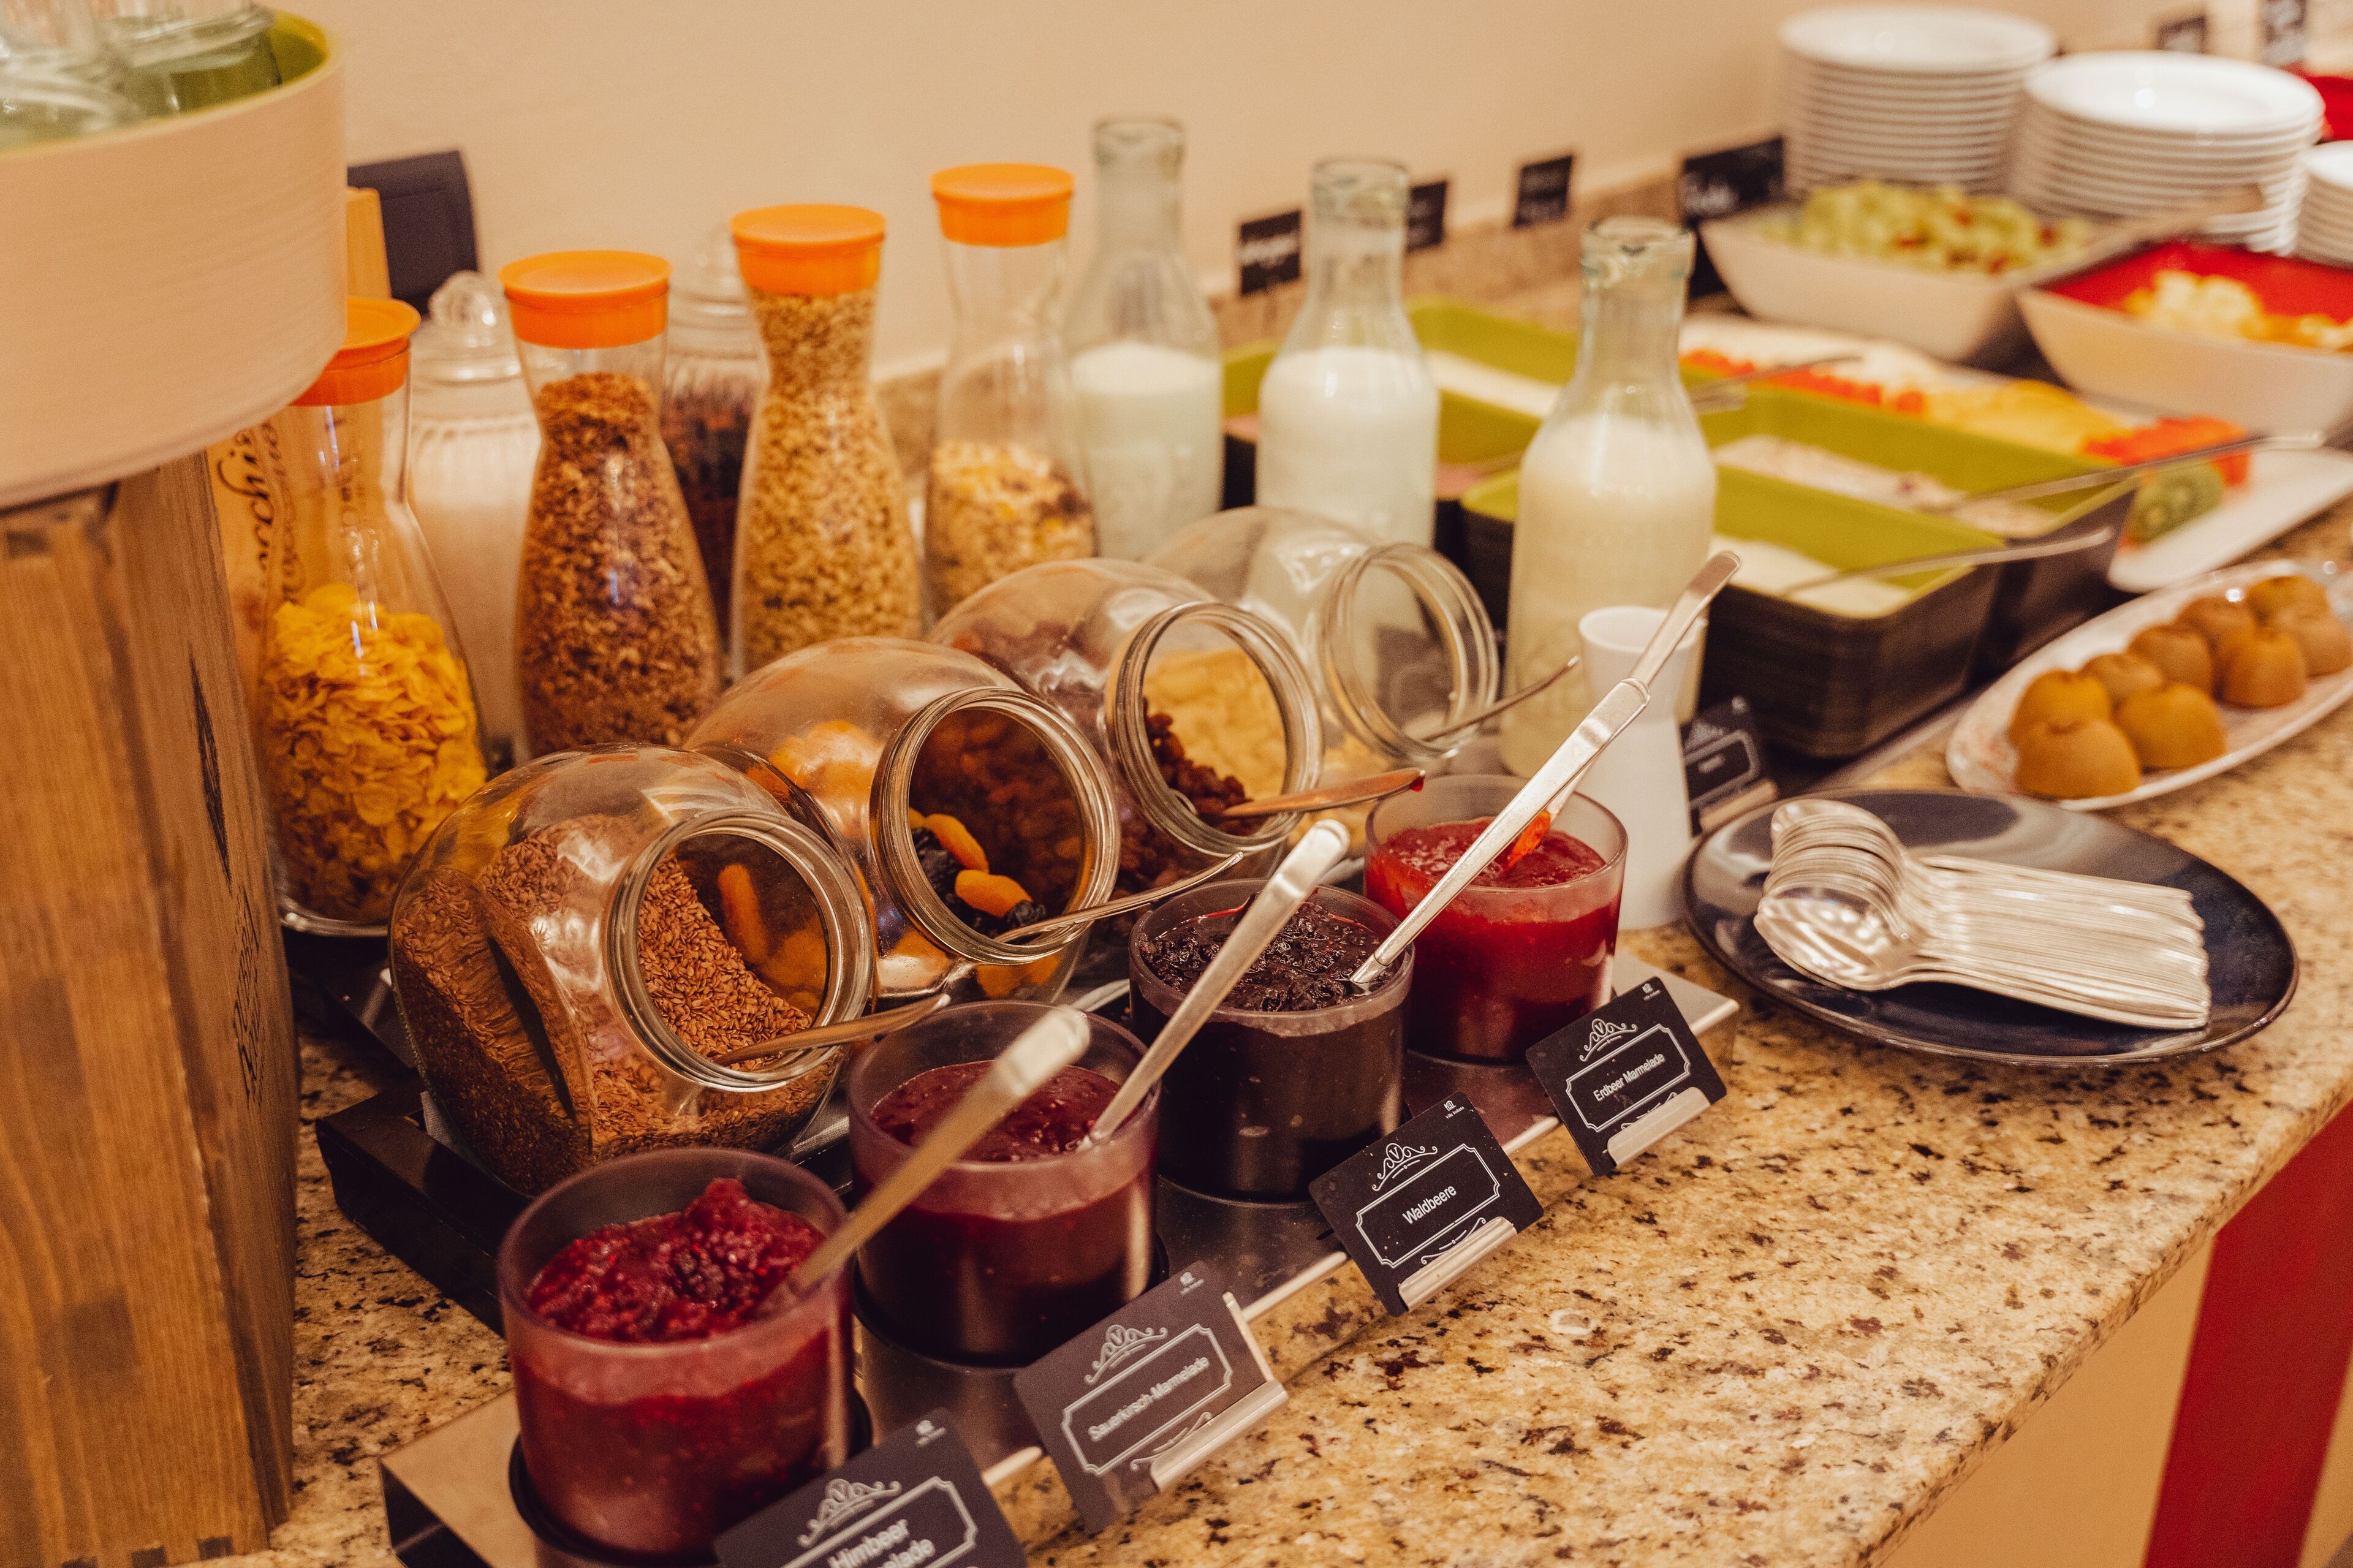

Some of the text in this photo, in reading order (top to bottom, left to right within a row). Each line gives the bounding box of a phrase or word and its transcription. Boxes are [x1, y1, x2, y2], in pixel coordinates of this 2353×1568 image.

[1593, 1053, 1666, 1102] Erdbeer Marmelade
[1402, 1185, 1457, 1225] Waldbeere
[1088, 1357, 1210, 1442] Sauerkirsch-Marmelade
[828, 1519, 910, 1568] Himbeer
